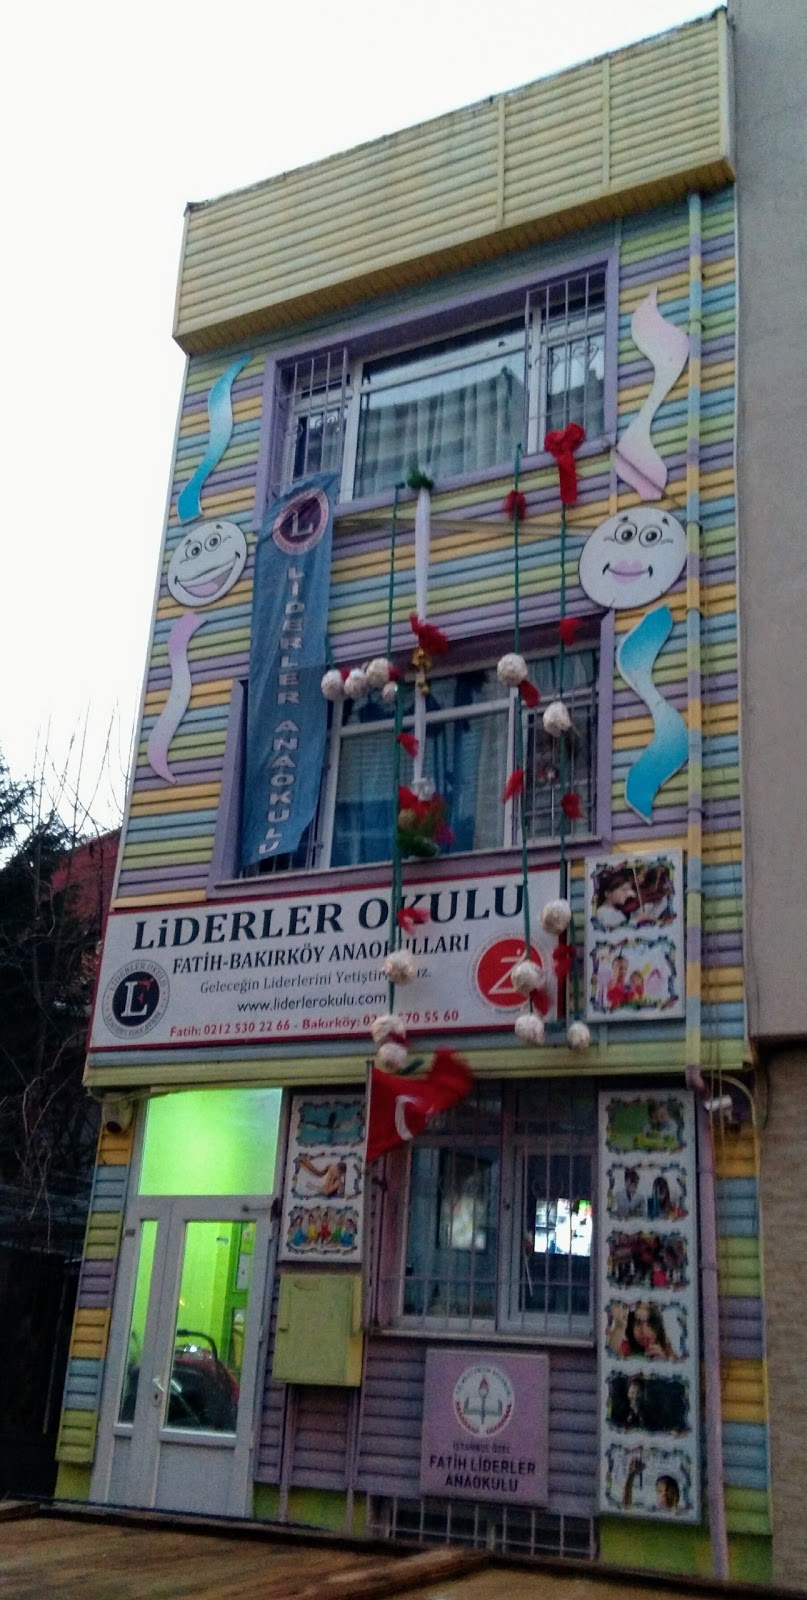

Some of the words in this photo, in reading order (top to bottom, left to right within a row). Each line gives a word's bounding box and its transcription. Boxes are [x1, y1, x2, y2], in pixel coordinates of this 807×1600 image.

[258, 720, 299, 855] ANAOKULU
[358, 884, 524, 930] OKULU
[172, 943, 325, 974] FATİH-BAKIRKÖY
[200, 979, 259, 994] Geleceğin
[264, 973, 331, 989] Liderlerini
[237, 992, 386, 1012] www.liderlerokulu.com
[170, 1024, 201, 1037] Fatih:
[204, 1023, 230, 1036] 0212
[235, 1022, 255, 1034] 530
[259, 1020, 272, 1032] 22
[276, 1019, 290, 1031] 66
[302, 1016, 359, 1030] Bakırköy:
[398, 1010, 420, 1024] 70
[425, 1010, 438, 1022] 55
[444, 1009, 459, 1021] 60
[430, 1454, 466, 1470] FATİH
[471, 1455, 536, 1476] LİDERLER
[445, 1474, 518, 1493] ANAOKULU
